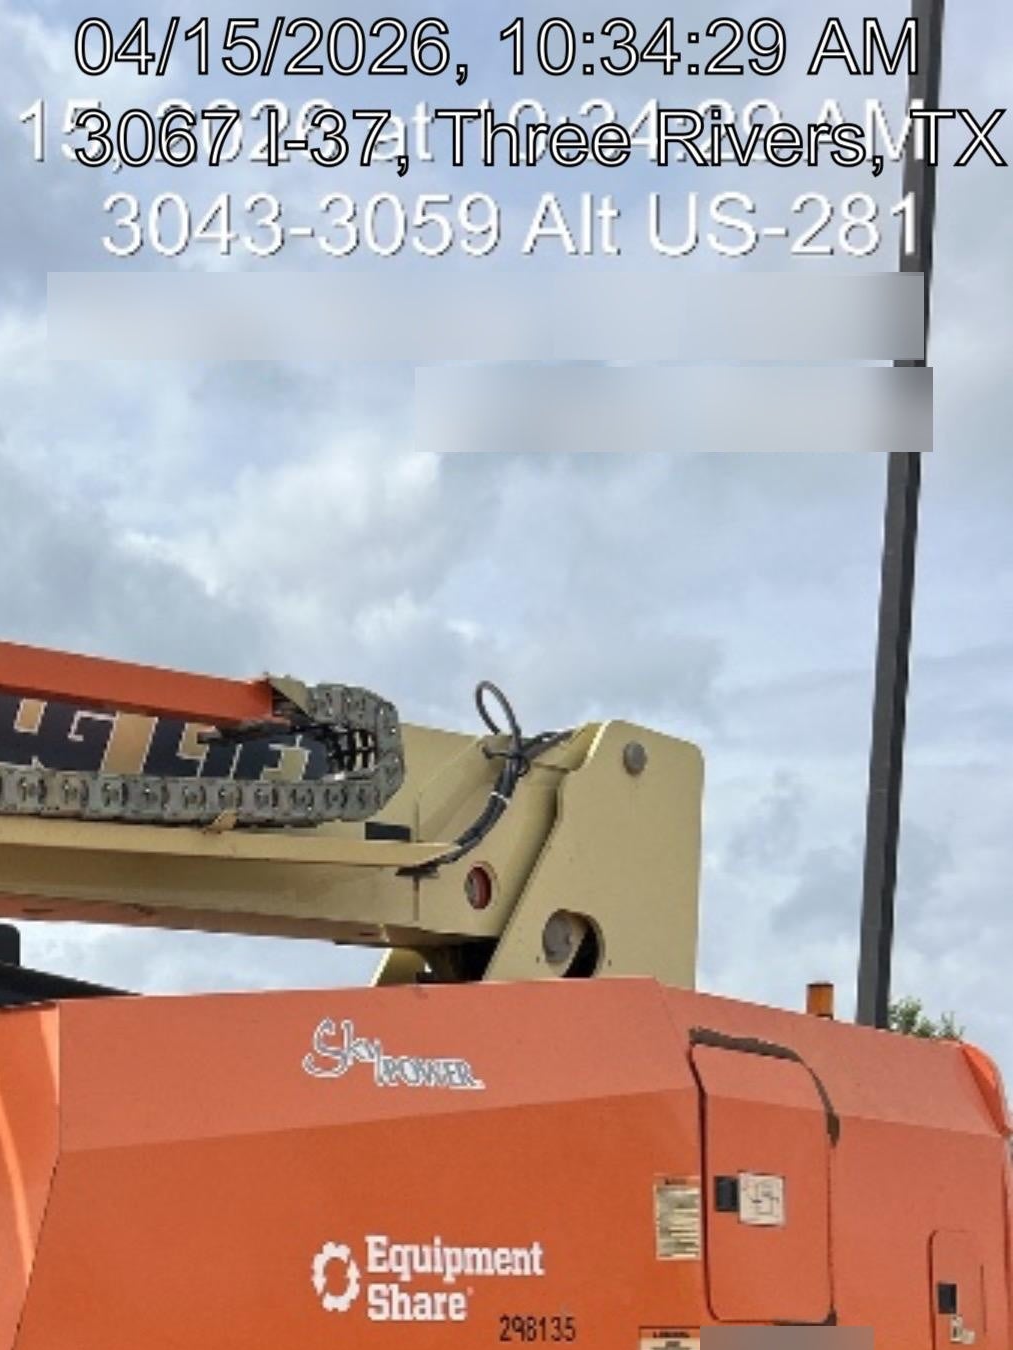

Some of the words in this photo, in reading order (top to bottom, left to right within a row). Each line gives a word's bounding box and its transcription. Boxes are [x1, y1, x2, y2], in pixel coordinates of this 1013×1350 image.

[365, 1235, 545, 1284] Equipment
[367, 1283, 468, 1321] Share
[499, 1314, 576, 1343] 298135
